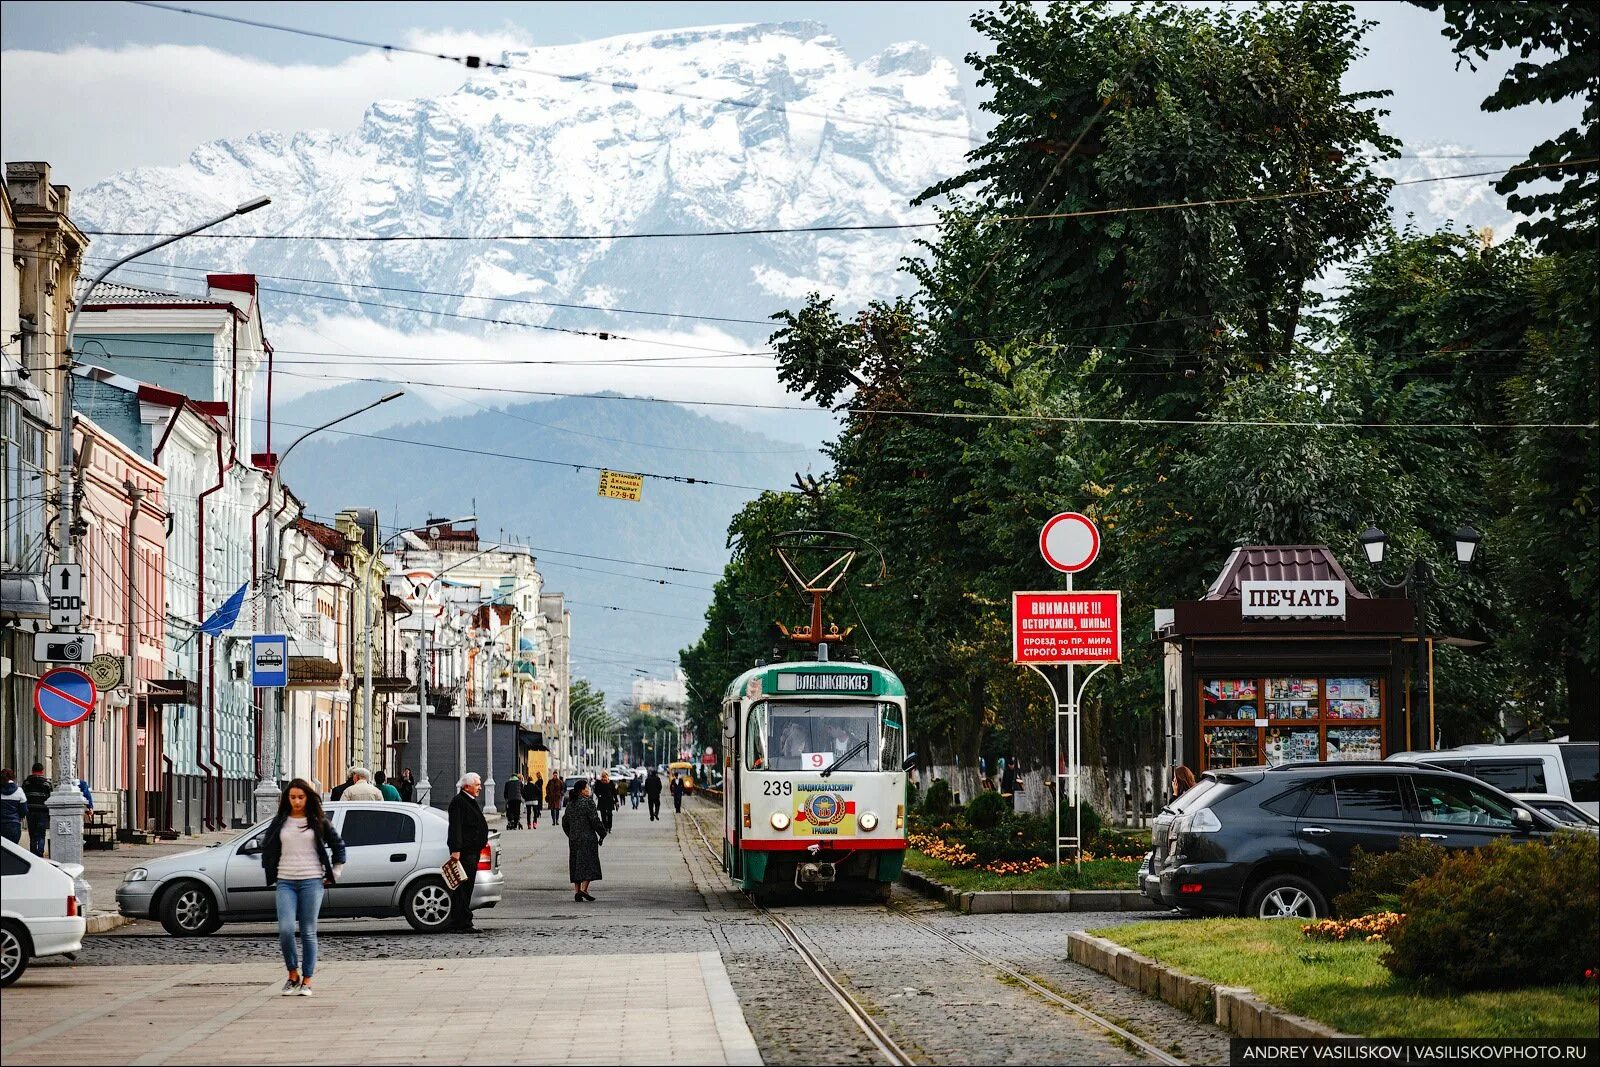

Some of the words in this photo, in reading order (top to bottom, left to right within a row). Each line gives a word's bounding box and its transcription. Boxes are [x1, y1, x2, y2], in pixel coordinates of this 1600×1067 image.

[51, 596, 80, 610] 500
[1249, 589, 1340, 607] ПЕЧАТЬ
[1031, 602, 1089, 615] ВНИМАНИЕ
[1022, 618, 1077, 630] ОСТОРОЖНО,
[1080, 618, 1111, 629] ШИПЫ!
[1023, 638, 1056, 646] ПРОЕЗД
[1023, 648, 1058, 656] СТРОГО
[1061, 648, 1112, 657] ЗАПРЕЩЕН!
[796, 674, 869, 690] ВЛАДИКАВКАЗ
[811, 754, 824, 767] 9
[763, 780, 792, 796] 239
[797, 783, 853, 792] ВЛАДИКАВКАЗСКОМУ
